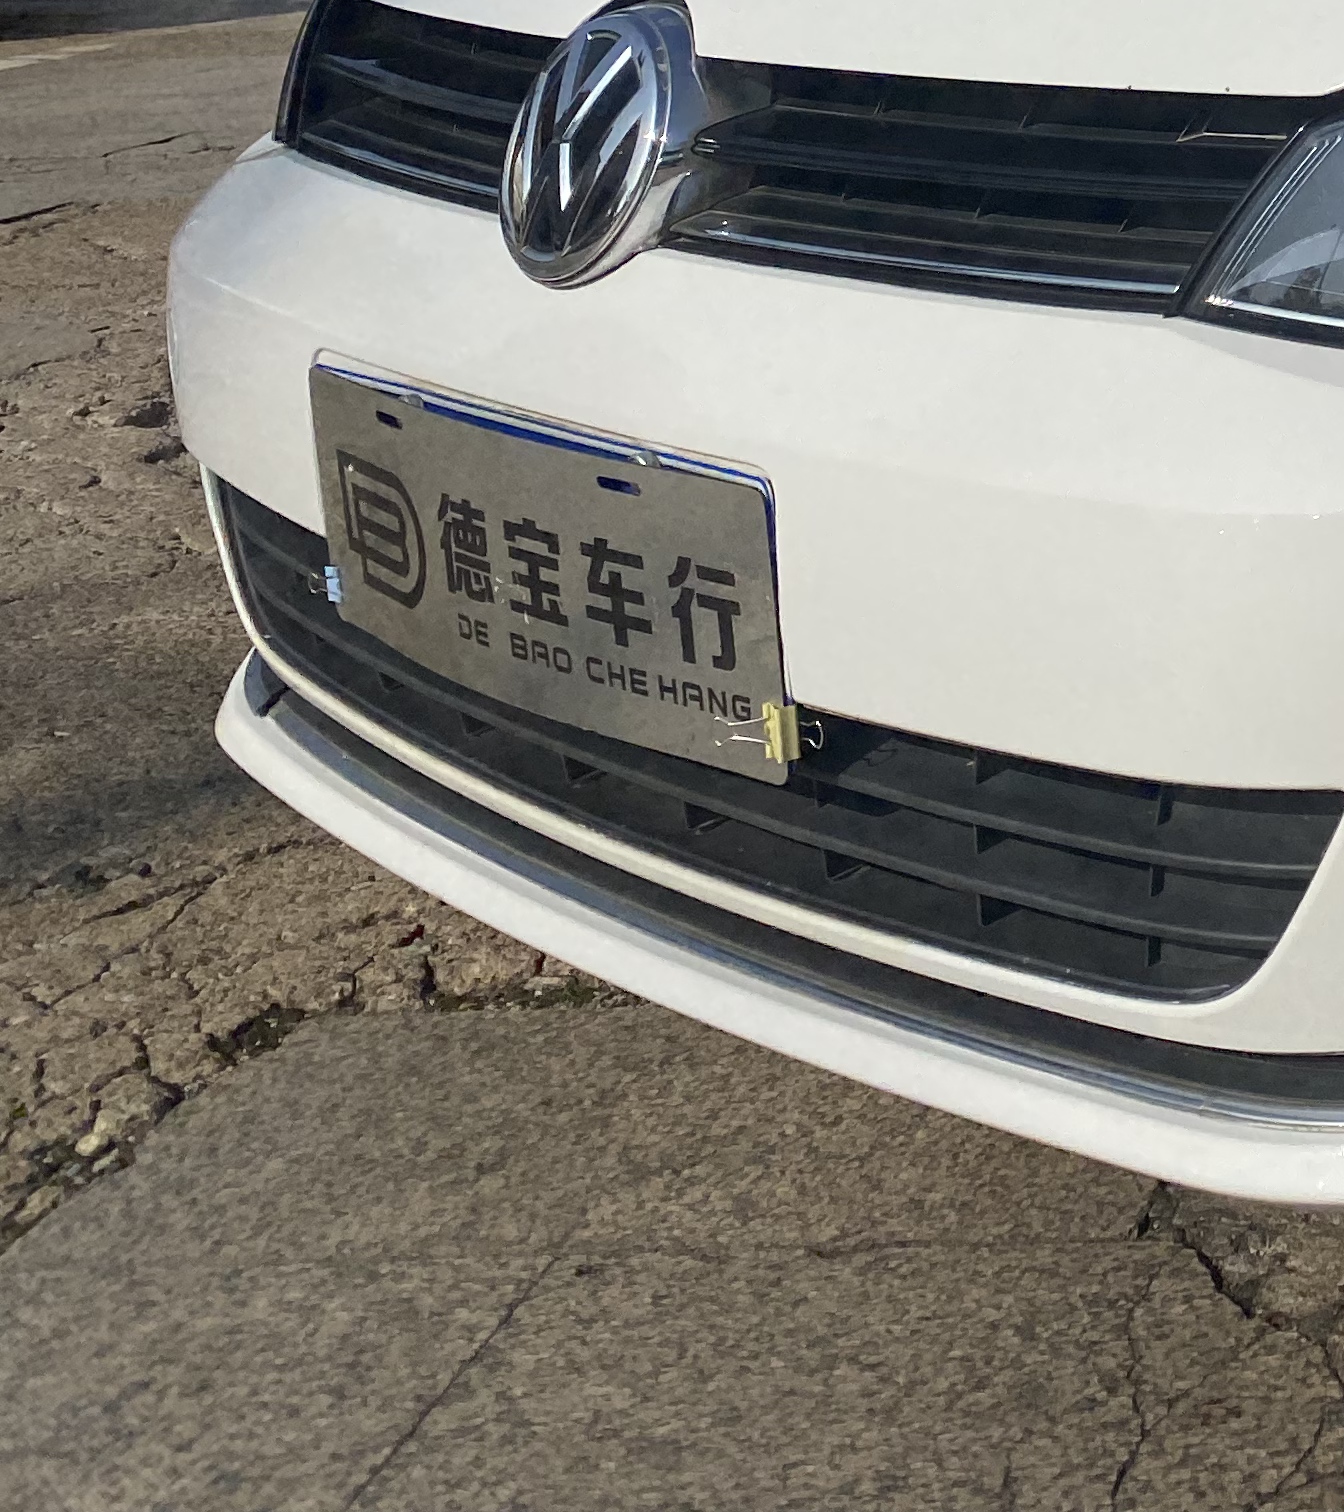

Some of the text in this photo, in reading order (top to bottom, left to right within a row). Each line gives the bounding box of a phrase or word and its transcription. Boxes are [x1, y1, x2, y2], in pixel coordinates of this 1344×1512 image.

[437, 491, 742, 672] 德宝车行
[457, 612, 753, 720] DE BAO CHE HANG
